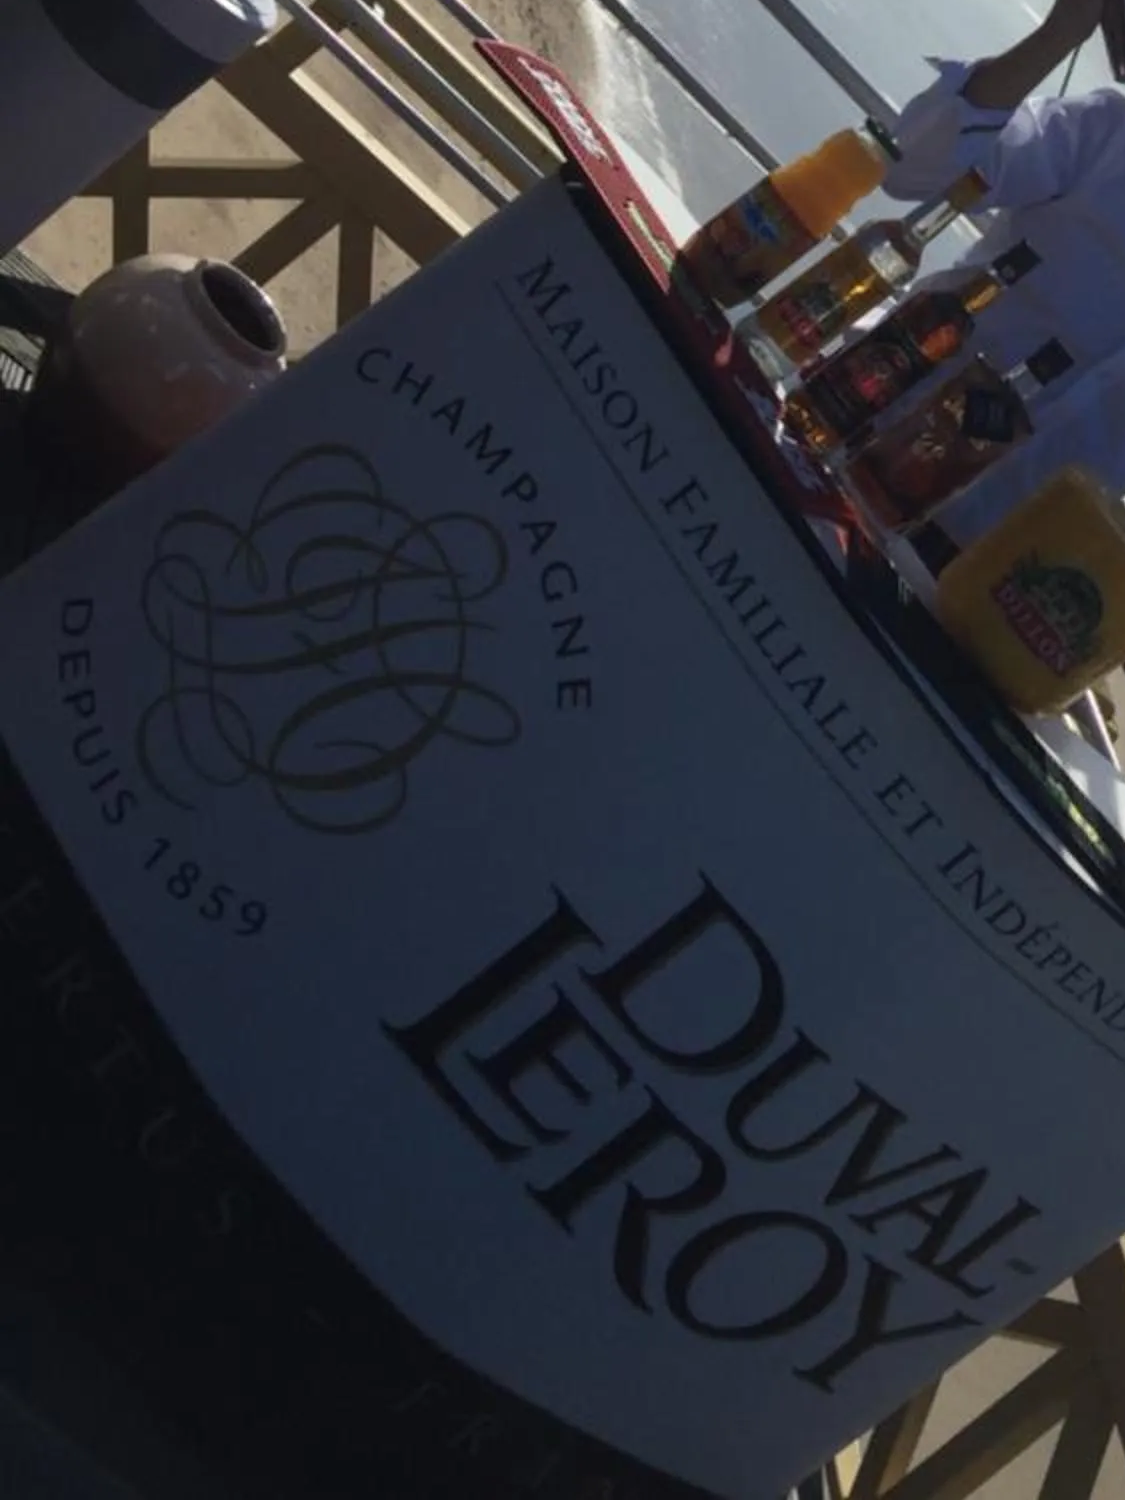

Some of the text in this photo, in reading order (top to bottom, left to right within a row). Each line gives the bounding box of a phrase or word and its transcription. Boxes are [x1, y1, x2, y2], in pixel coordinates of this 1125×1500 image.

[355, 346, 593, 710] CHAMPAGNE
[519, 259, 667, 471] MAISON
[657, 476, 876, 770] FAMILIALE
[874, 772, 945, 838] ET
[57, 598, 270, 938] DEPUIS 1859
[0, 815, 255, 1238] ERTUS
[379, 883, 981, 1393] LEROY
[578, 871, 1043, 1300] DUVAL-
